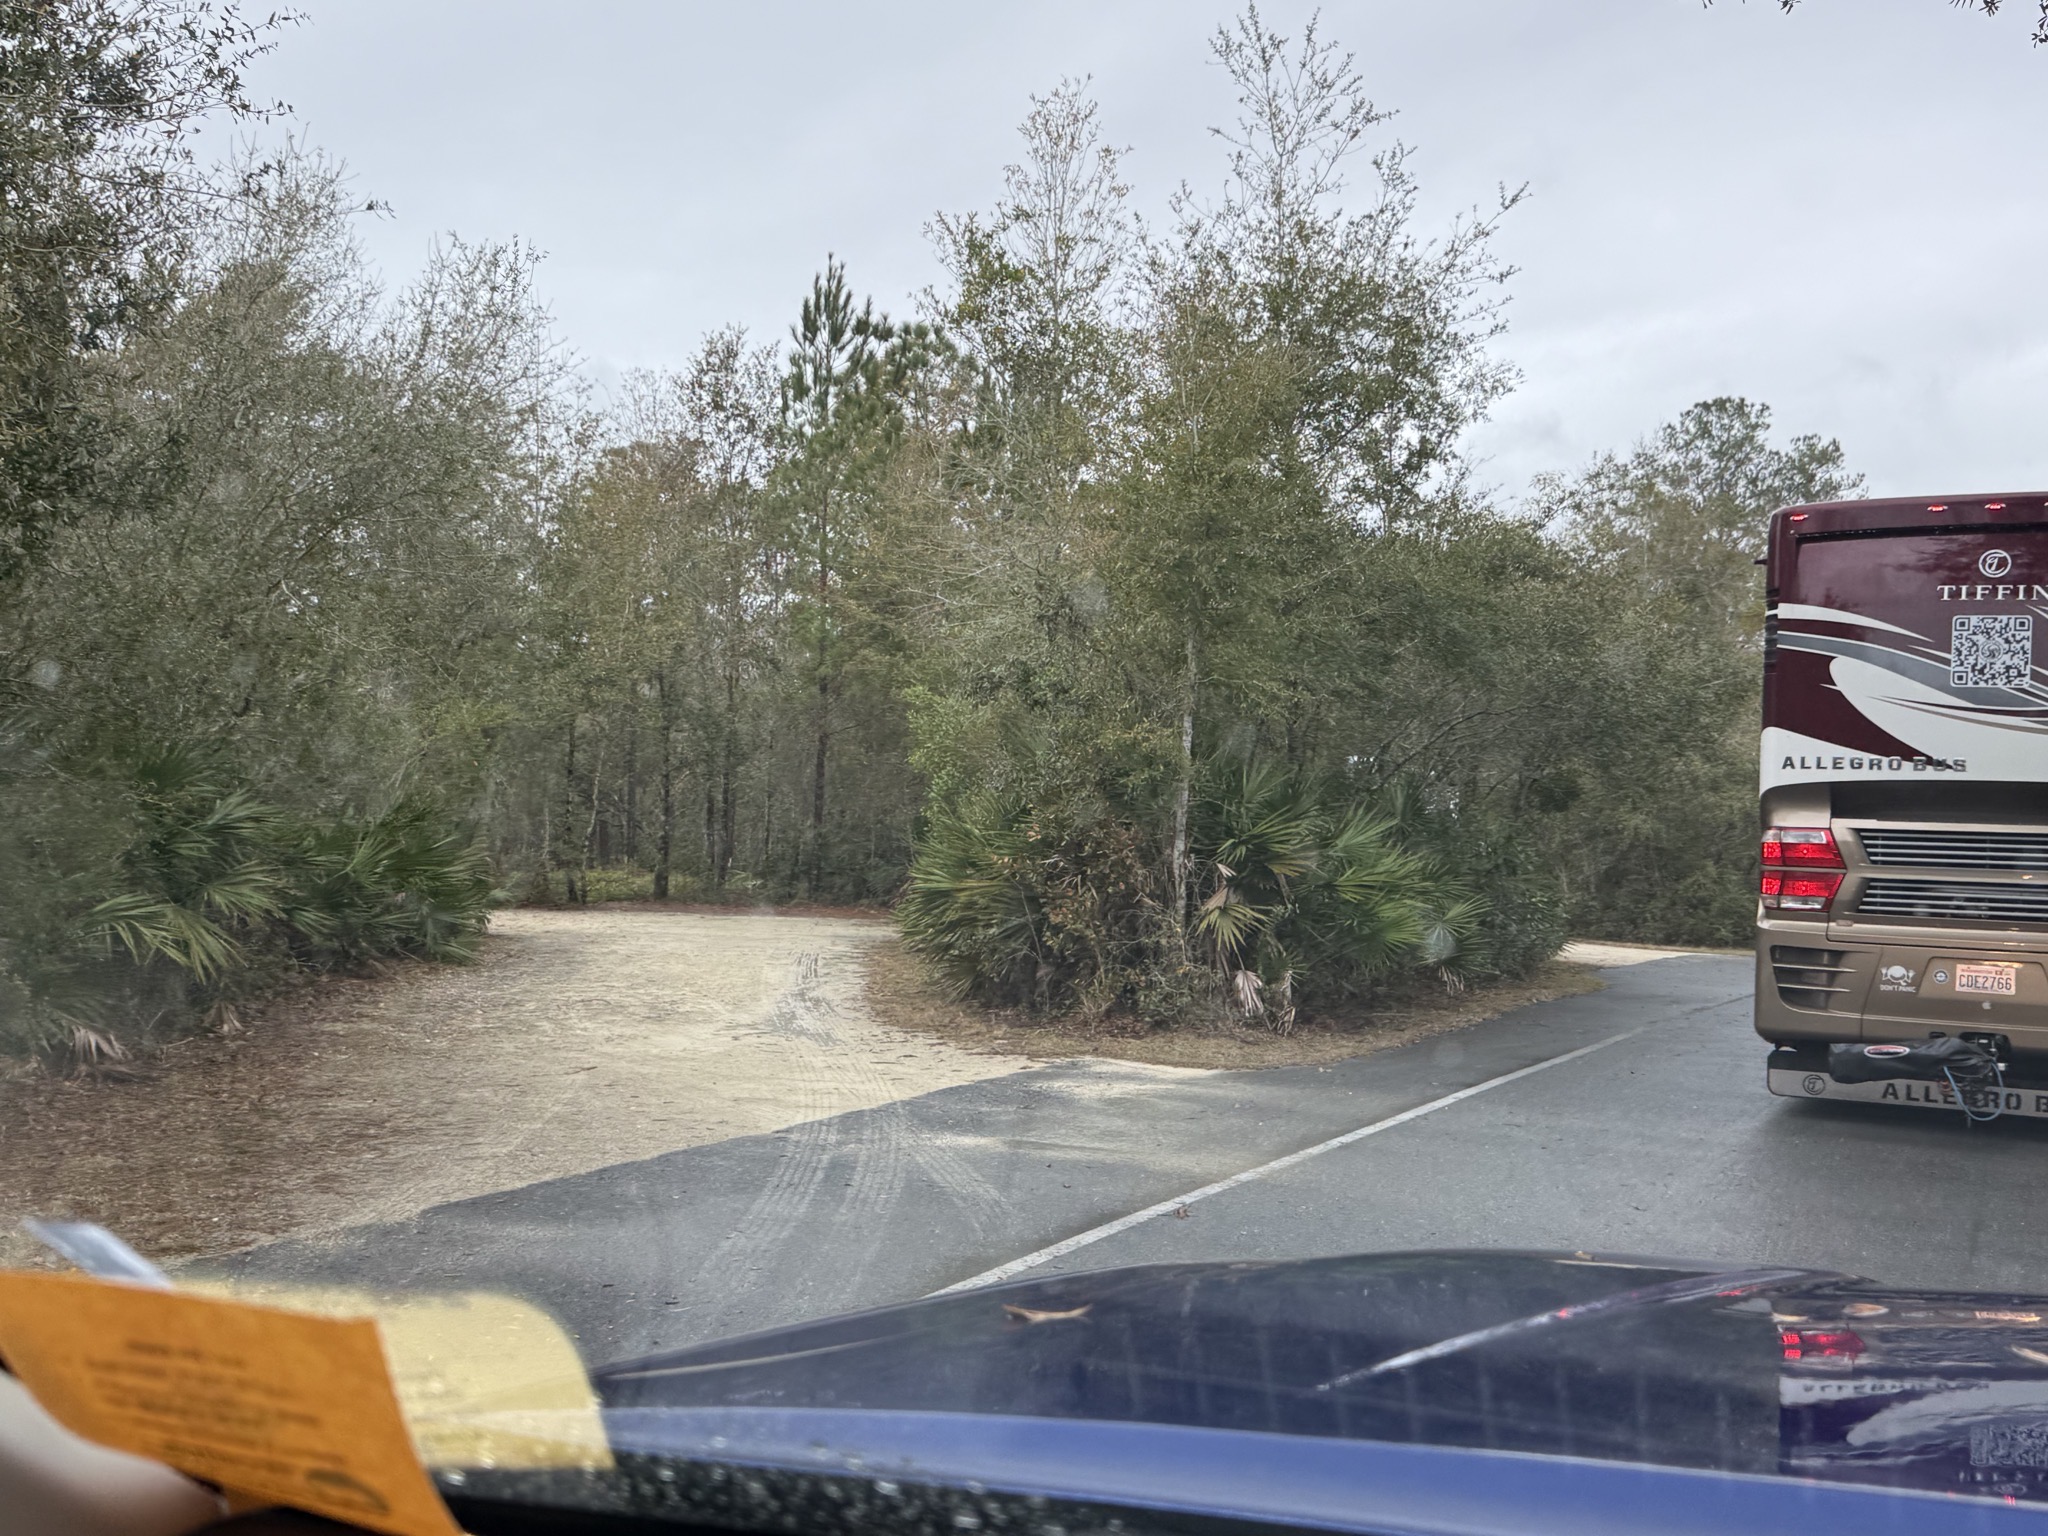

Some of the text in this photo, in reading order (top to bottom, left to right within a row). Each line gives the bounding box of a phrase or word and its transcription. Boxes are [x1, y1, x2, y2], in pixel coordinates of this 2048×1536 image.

[1936, 584, 2048, 601] TIFFIN
[1781, 756, 1968, 773] ALLEGRO BUS
[1958, 974, 2012, 990] CDE2766
